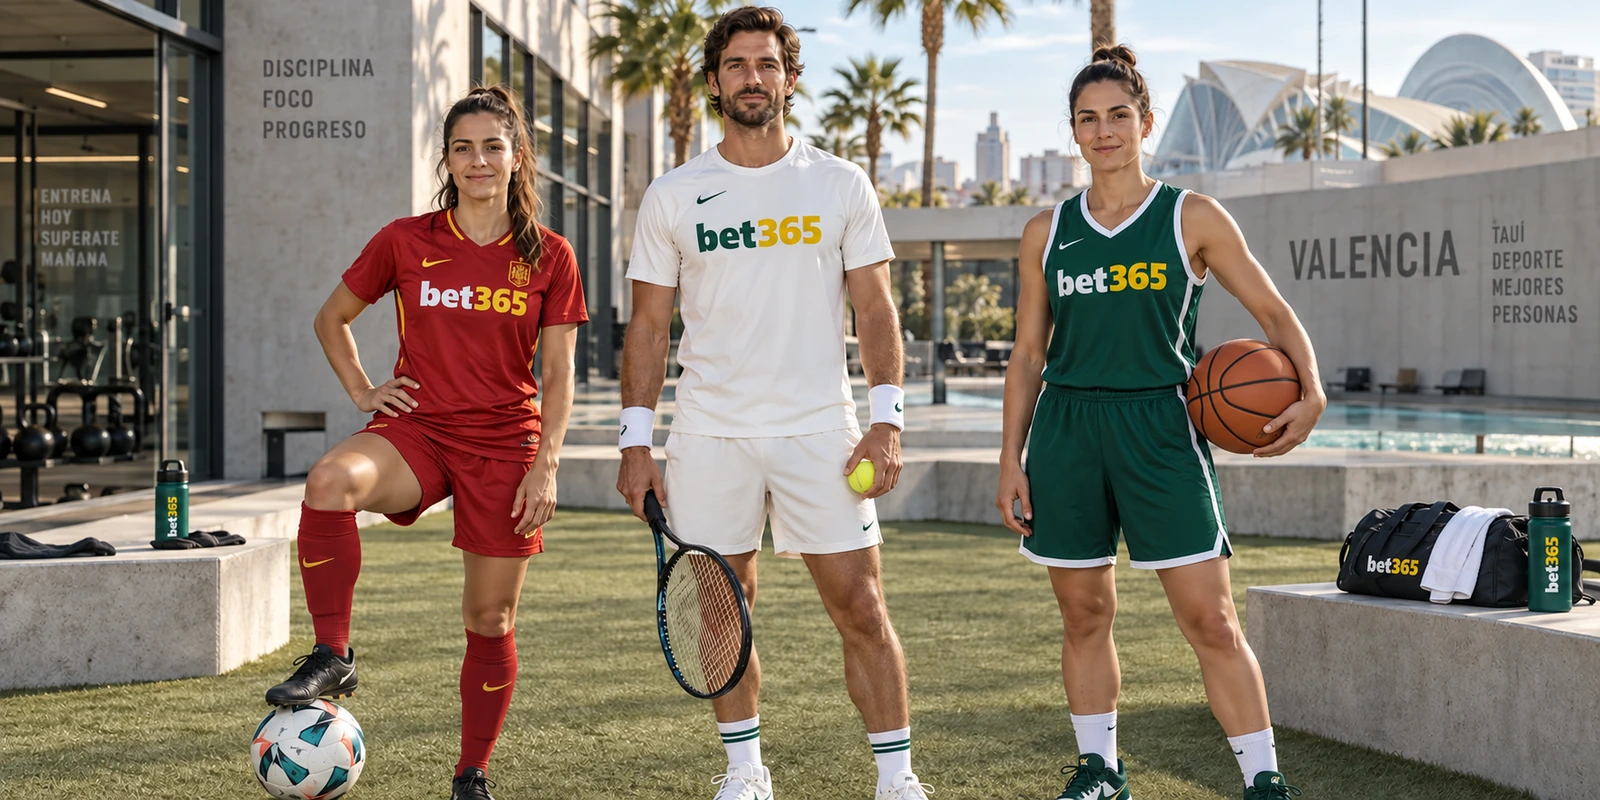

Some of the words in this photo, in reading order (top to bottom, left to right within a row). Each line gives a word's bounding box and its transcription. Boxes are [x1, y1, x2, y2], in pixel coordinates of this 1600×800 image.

[263, 58, 375, 77] DISCIPLINA
[263, 89, 313, 108] FOCO
[263, 120, 366, 139] PROGRESO
[41, 188, 112, 204] ENTRENA
[41, 209, 72, 225] HOY
[41, 230, 119, 246] SUPERATE
[695, 215, 822, 253] bet365
[41, 248, 108, 267] MAÑANA
[1289, 230, 1460, 281] VALENCIA
[1492, 249, 1563, 270] DEPORTE
[1057, 262, 1167, 297] bet365
[1492, 277, 1564, 296] MEJORES
[420, 280, 528, 316] bet365
[1492, 304, 1578, 324] PERSONAS
[167, 496, 178, 537] bet365
[1367, 555, 1420, 576] bet365
[1545, 536, 1559, 593] bet365
